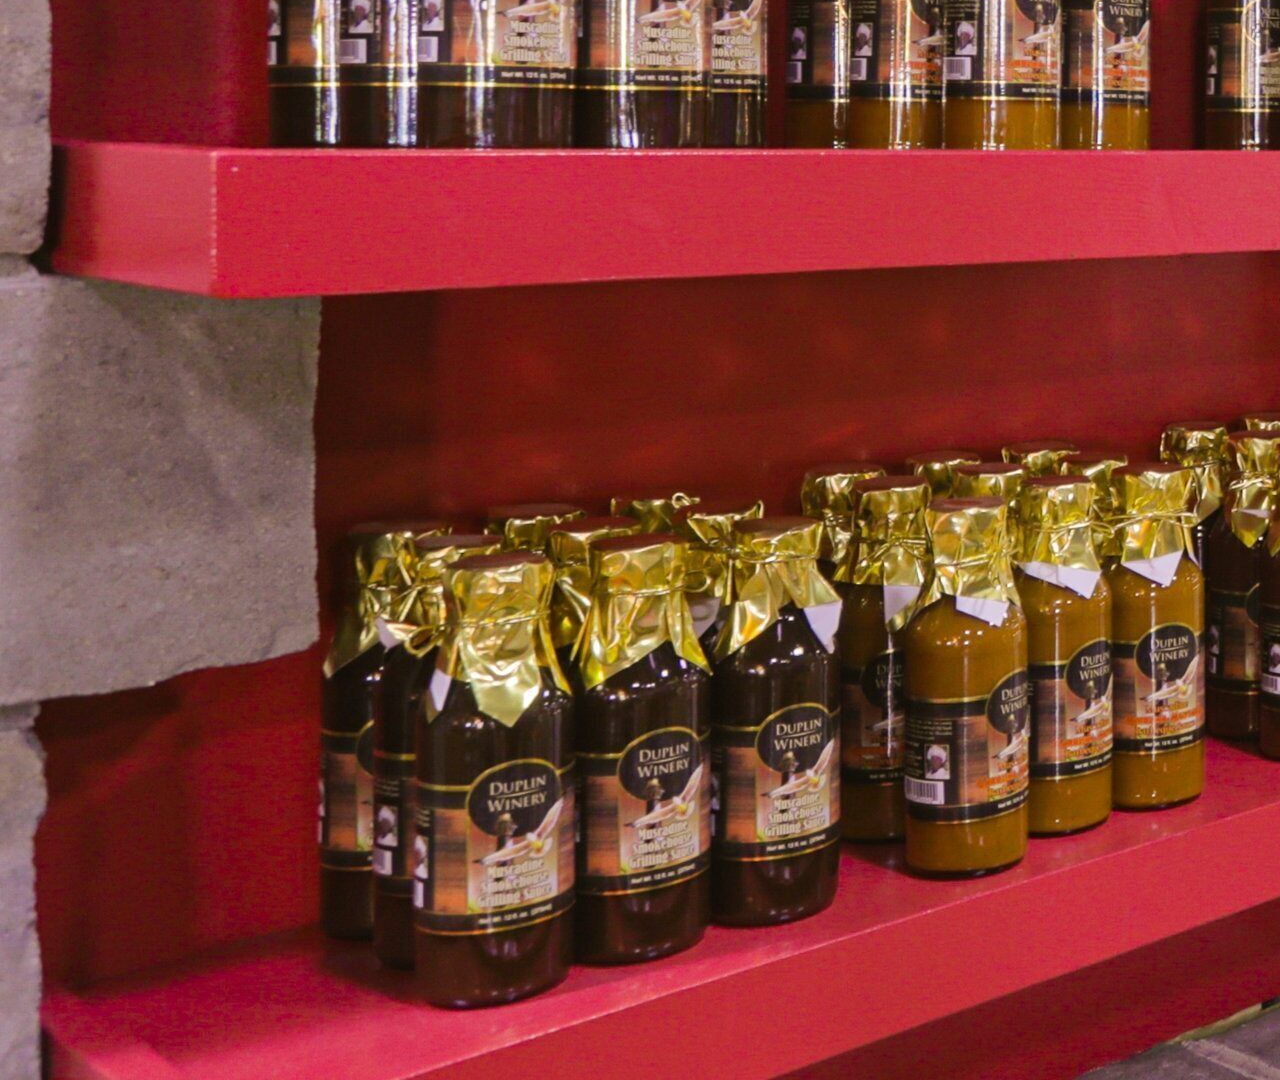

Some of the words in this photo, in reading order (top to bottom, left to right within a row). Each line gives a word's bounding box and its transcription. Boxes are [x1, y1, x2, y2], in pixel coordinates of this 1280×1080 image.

[1108, 5, 1143, 18] WINERY
[642, 26, 693, 40] Muscadine
[637, 40, 698, 55] Smokehouse
[1149, 649, 1189, 662] WINERY
[775, 718, 822, 737] DUPLIN
[773, 732, 823, 751] WINERY
[639, 742, 690, 764] DUPLIN
[637, 757, 690, 779] WINERY
[489, 775, 548, 796] DUPLIN
[487, 792, 548, 813] WINERY
[774, 792, 820, 810] Muscadine
[768, 804, 824, 823] Smokehouse
[638, 820, 688, 840] Muscadine
[764, 819, 801, 837] Grilling
[633, 833, 693, 854] Smokehouse
[488, 858, 544, 880] Muscadine
[630, 850, 667, 869] Grilling
